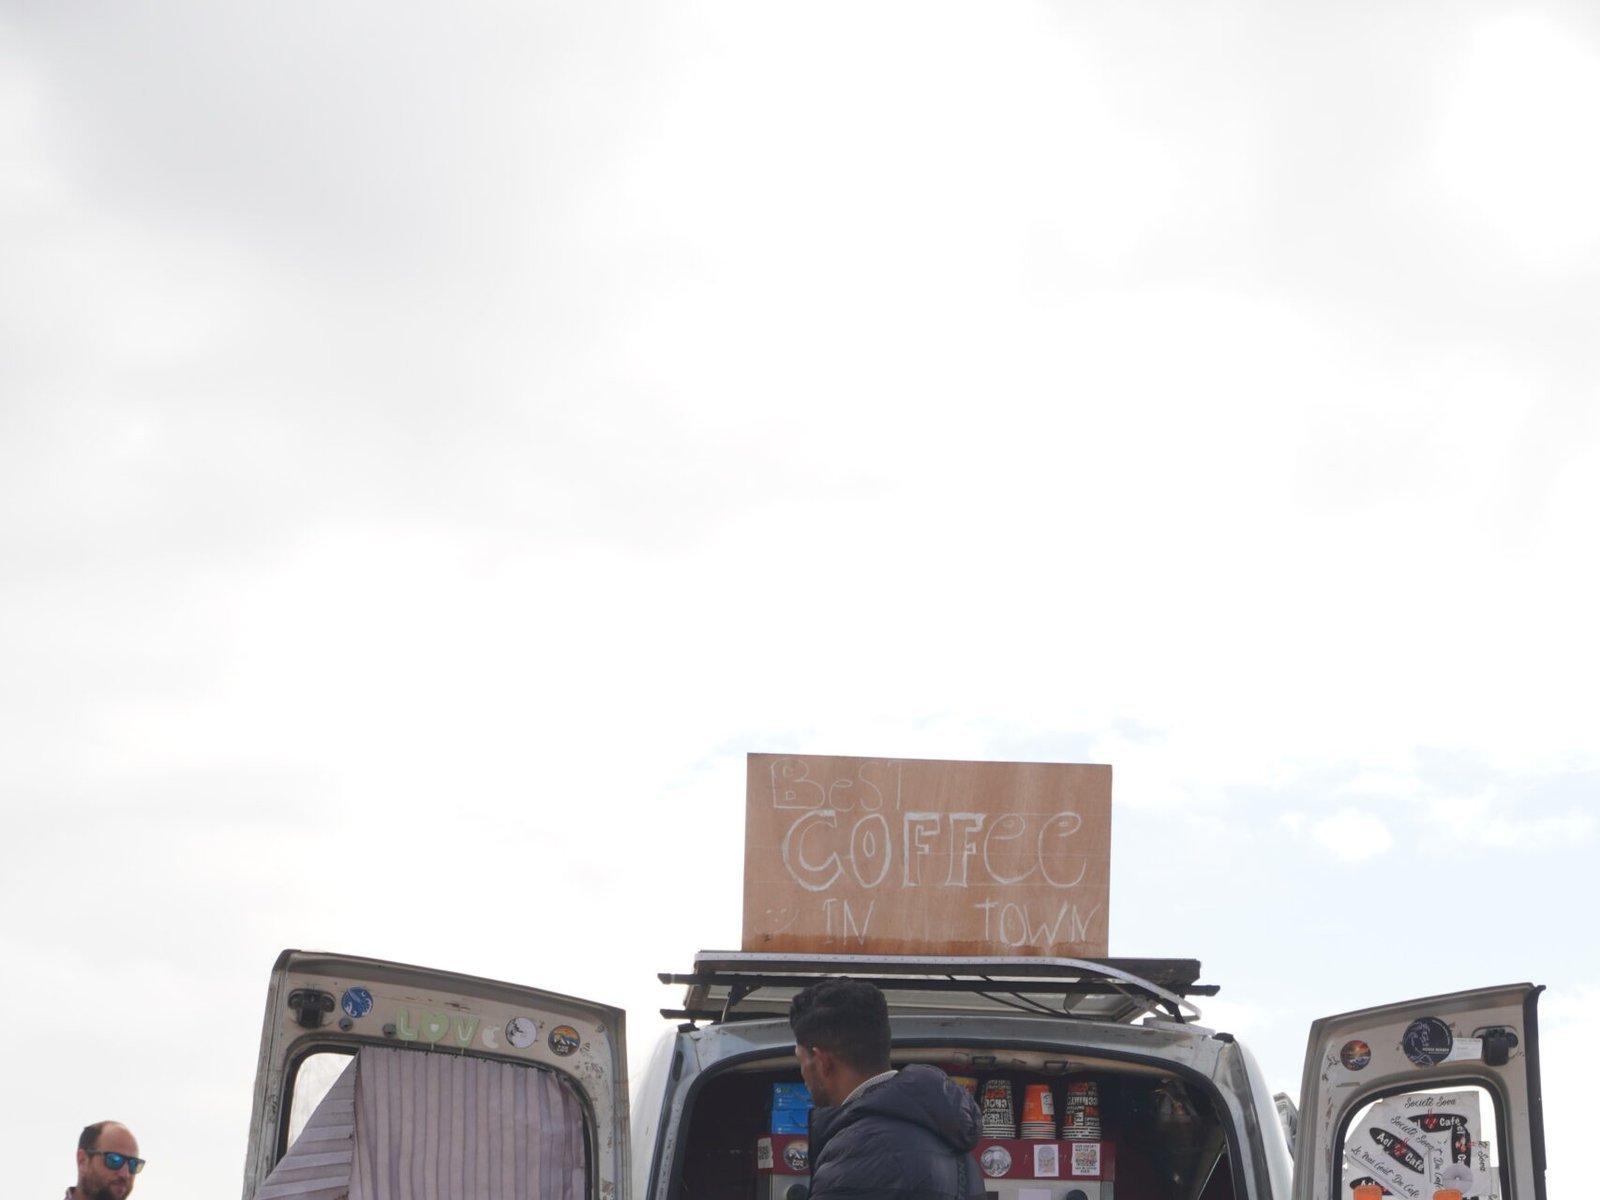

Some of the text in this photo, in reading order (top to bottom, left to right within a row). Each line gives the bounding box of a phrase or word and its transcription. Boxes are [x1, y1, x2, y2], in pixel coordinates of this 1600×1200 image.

[822, 896, 1102, 949] IN TOWN
[1405, 1153, 1424, 1171] Café
